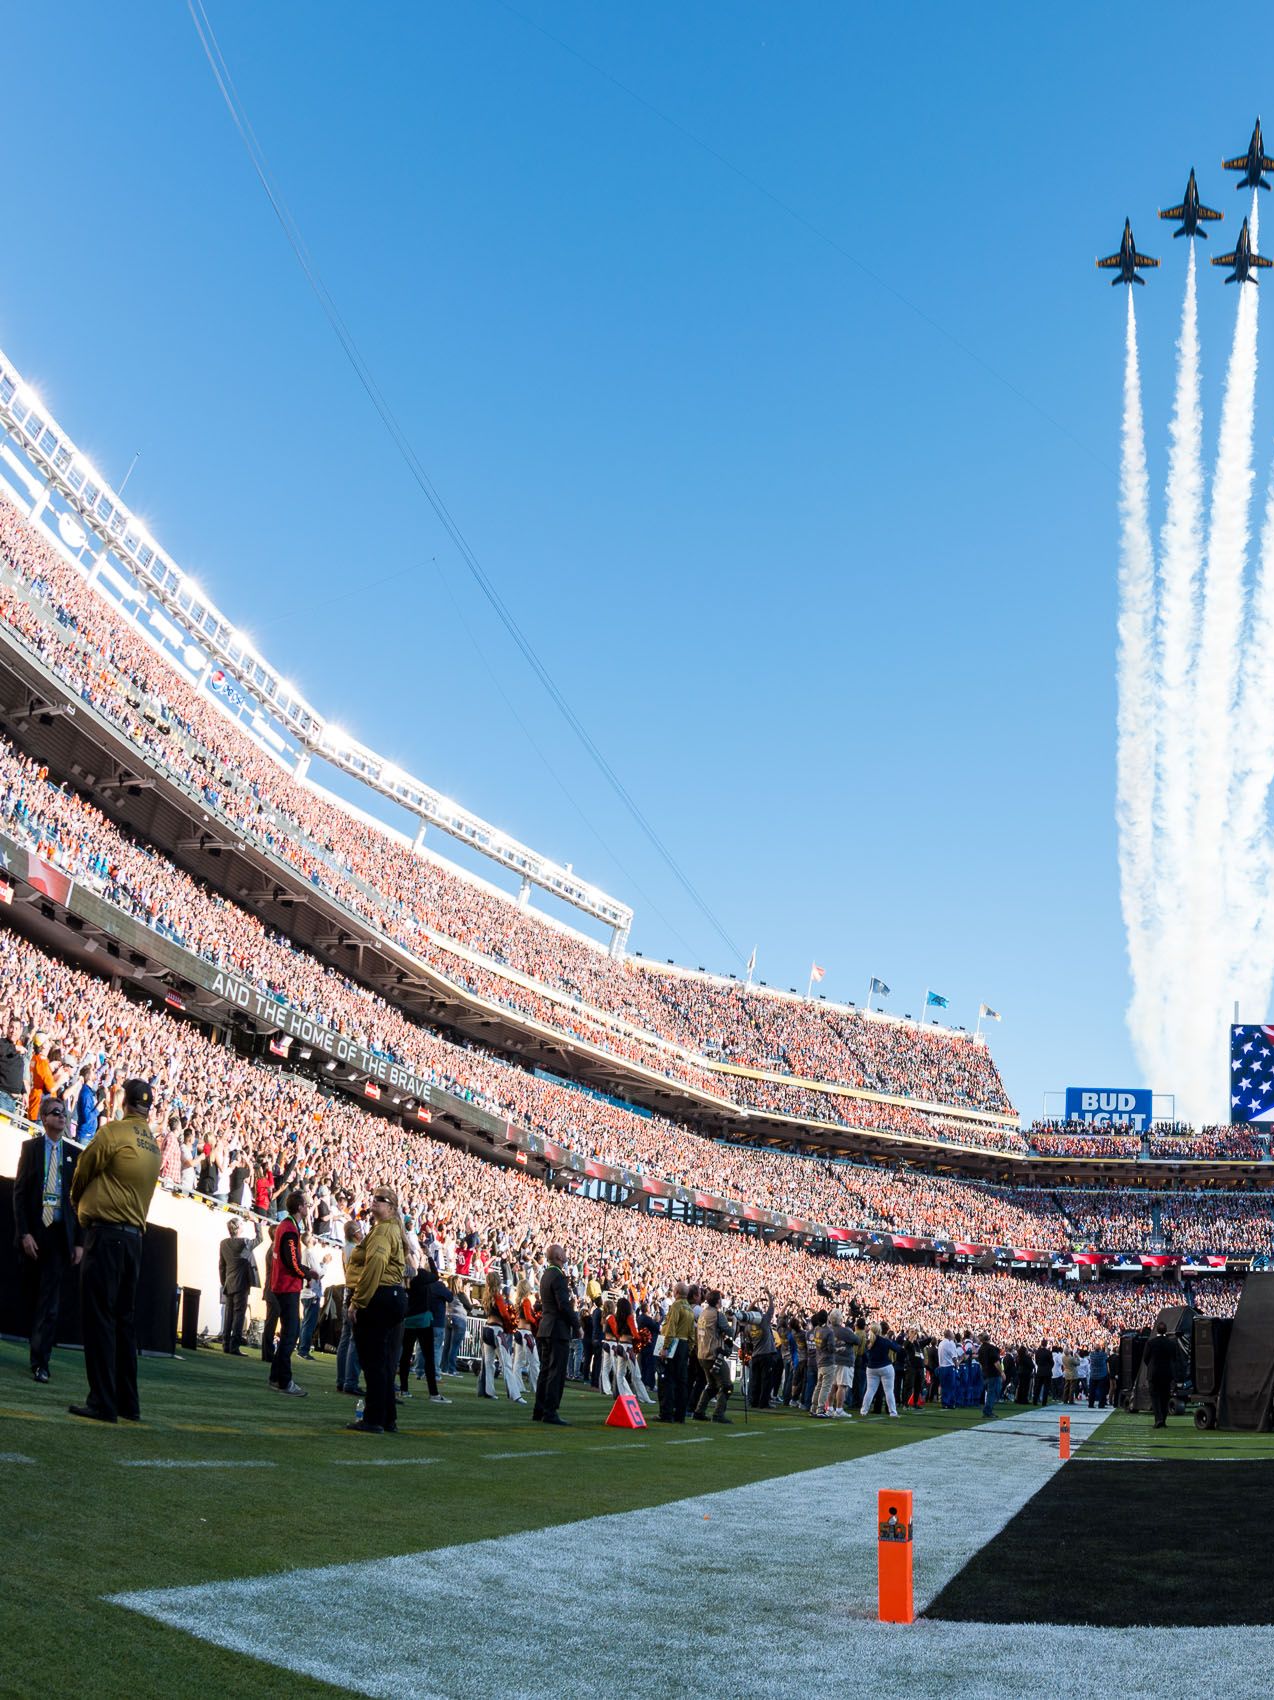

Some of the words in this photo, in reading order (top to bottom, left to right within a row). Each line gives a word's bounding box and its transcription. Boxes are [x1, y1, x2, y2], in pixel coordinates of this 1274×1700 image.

[211, 973, 250, 1007] AND
[255, 994, 287, 1028] THE
[290, 1014, 334, 1051] HOME
[337, 1041, 357, 1062] OF
[361, 1048, 387, 1077] THE
[389, 1070, 432, 1101] BRAVE
[1081, 1092, 1136, 1111] BUD
[626, 1400, 644, 1426] G
